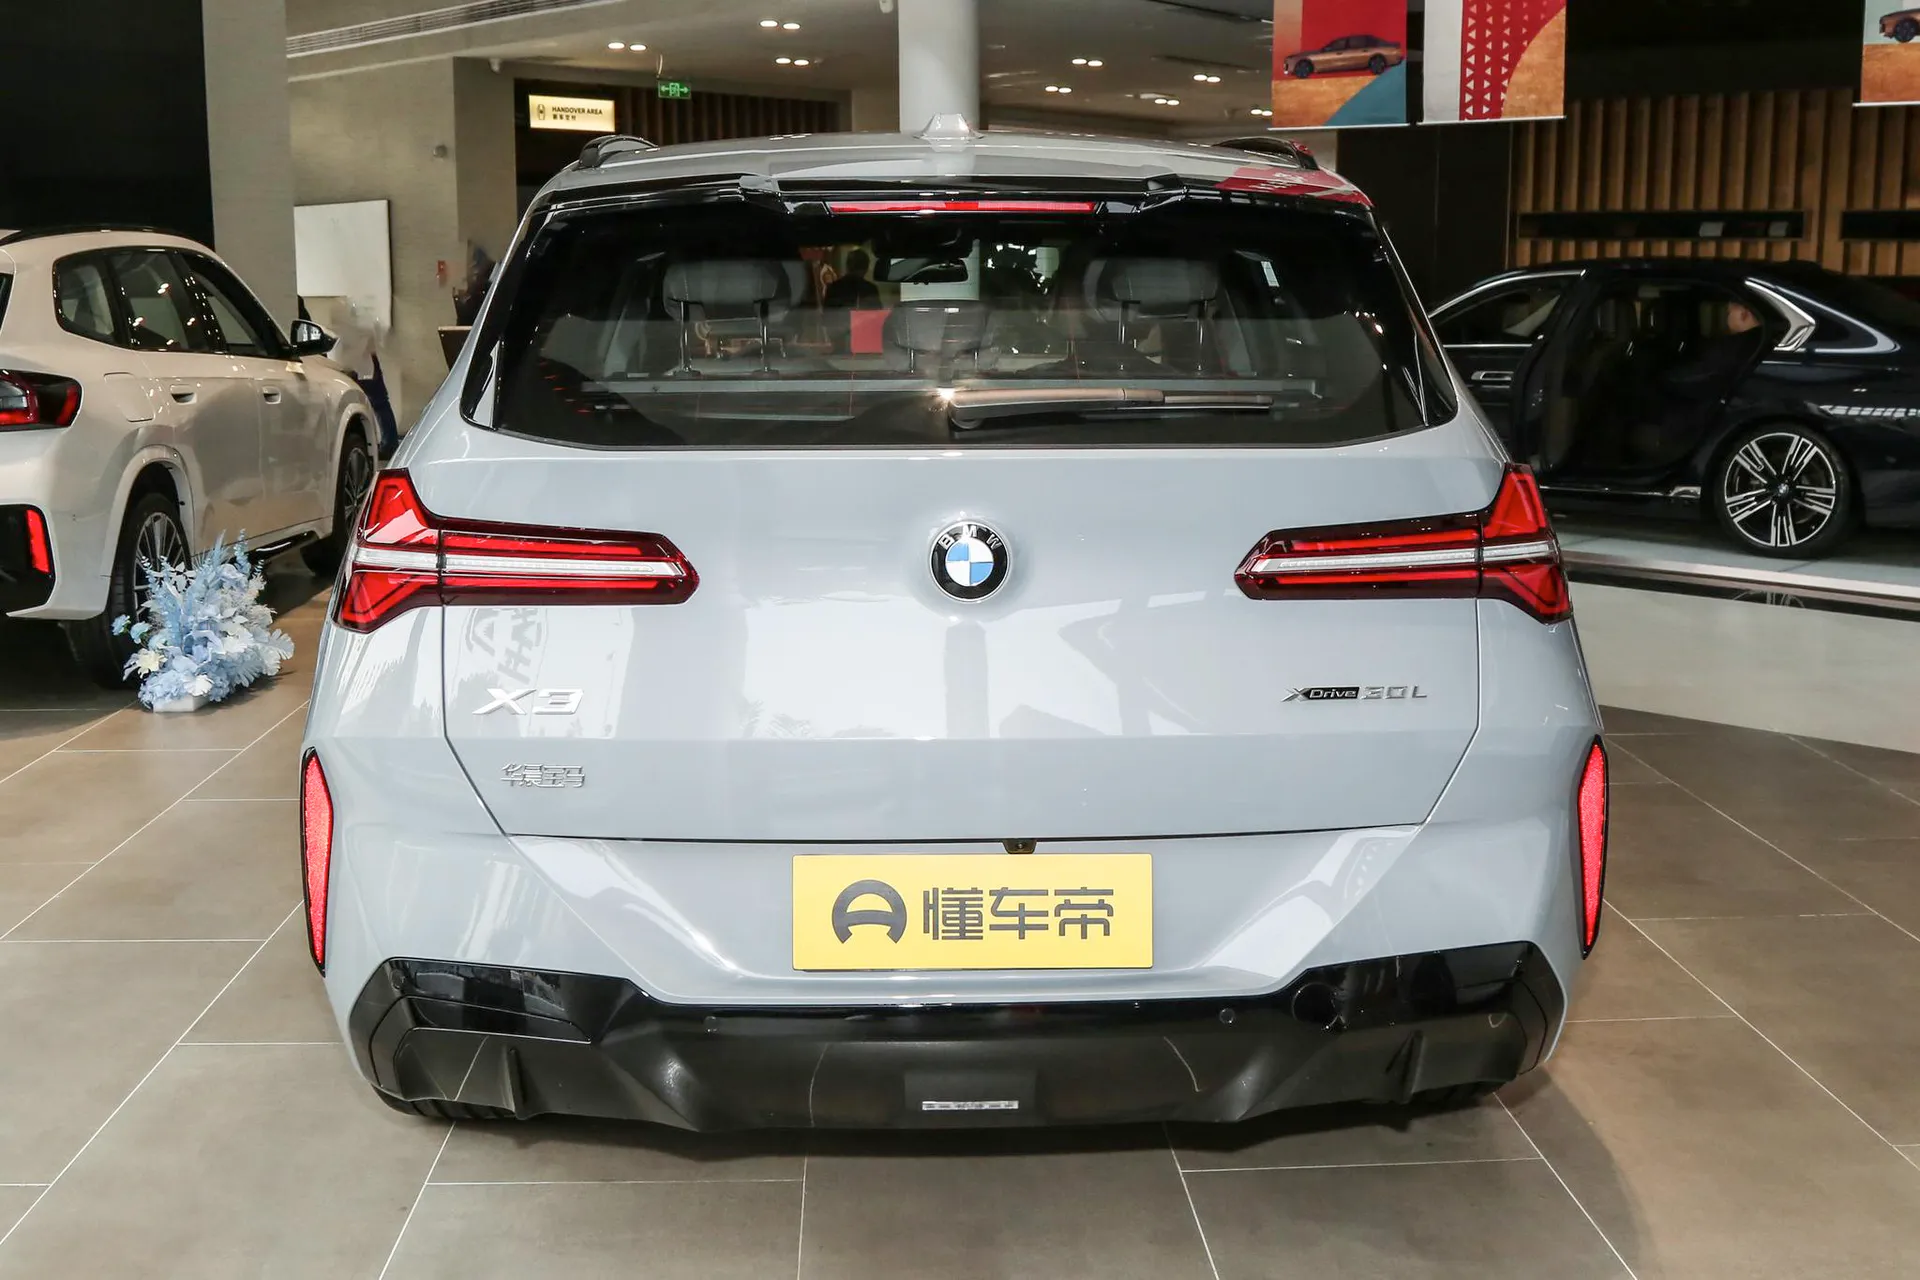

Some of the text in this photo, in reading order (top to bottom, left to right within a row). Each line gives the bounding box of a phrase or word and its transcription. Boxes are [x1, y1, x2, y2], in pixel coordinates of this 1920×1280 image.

[552, 106, 585, 114] HANDOVER
[938, 524, 1002, 550] BMW
[472, 688, 584, 715] X3
[1361, 686, 1427, 699] 30L
[500, 763, 585, 787] 华晨宝马
[923, 887, 1114, 940] 懂车帝
